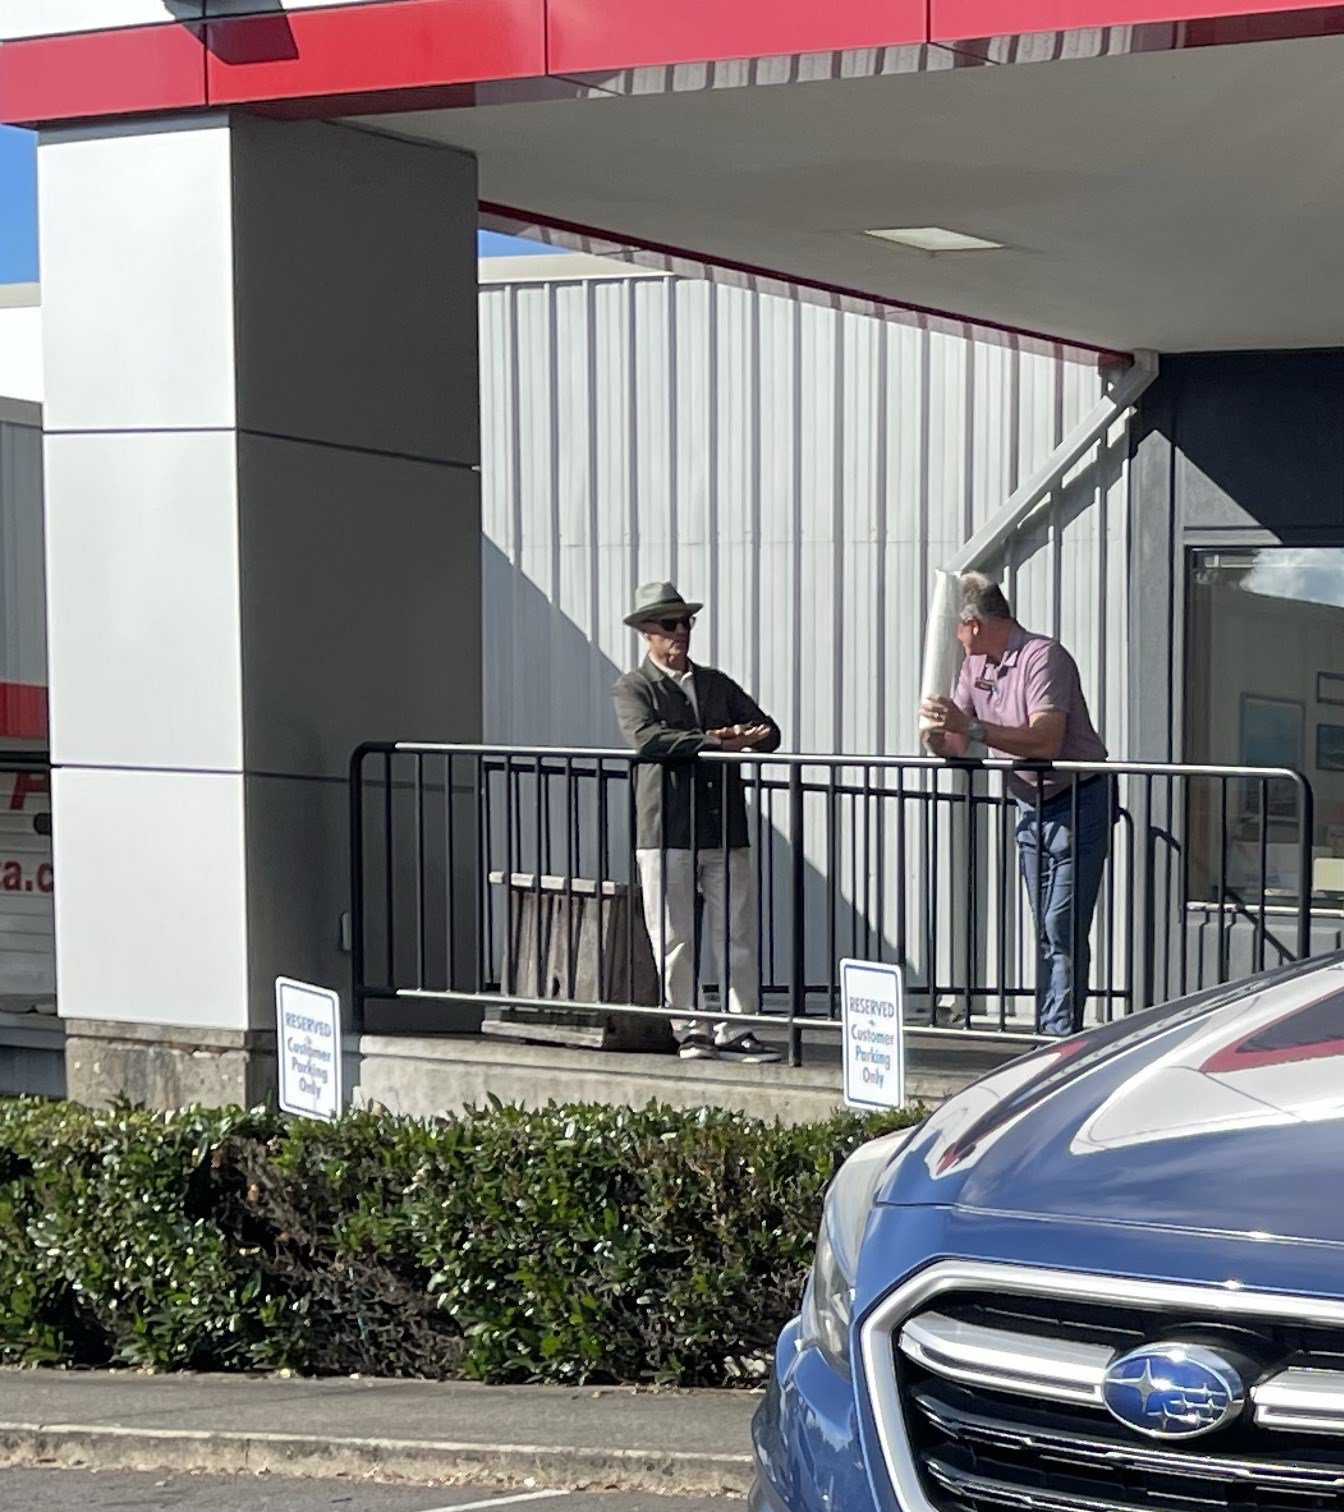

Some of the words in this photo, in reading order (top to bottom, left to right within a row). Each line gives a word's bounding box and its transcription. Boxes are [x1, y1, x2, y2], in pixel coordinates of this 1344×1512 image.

[849, 996, 895, 1018] RESERVED
[285, 1012, 332, 1037] RESERVED
[851, 1024, 894, 1046] Customer
[287, 1036, 331, 1062] Customer
[855, 1044, 891, 1070] Parking
[291, 1056, 328, 1084] Parking
[862, 1067, 884, 1089] Only
[299, 1077, 321, 1099] Only
